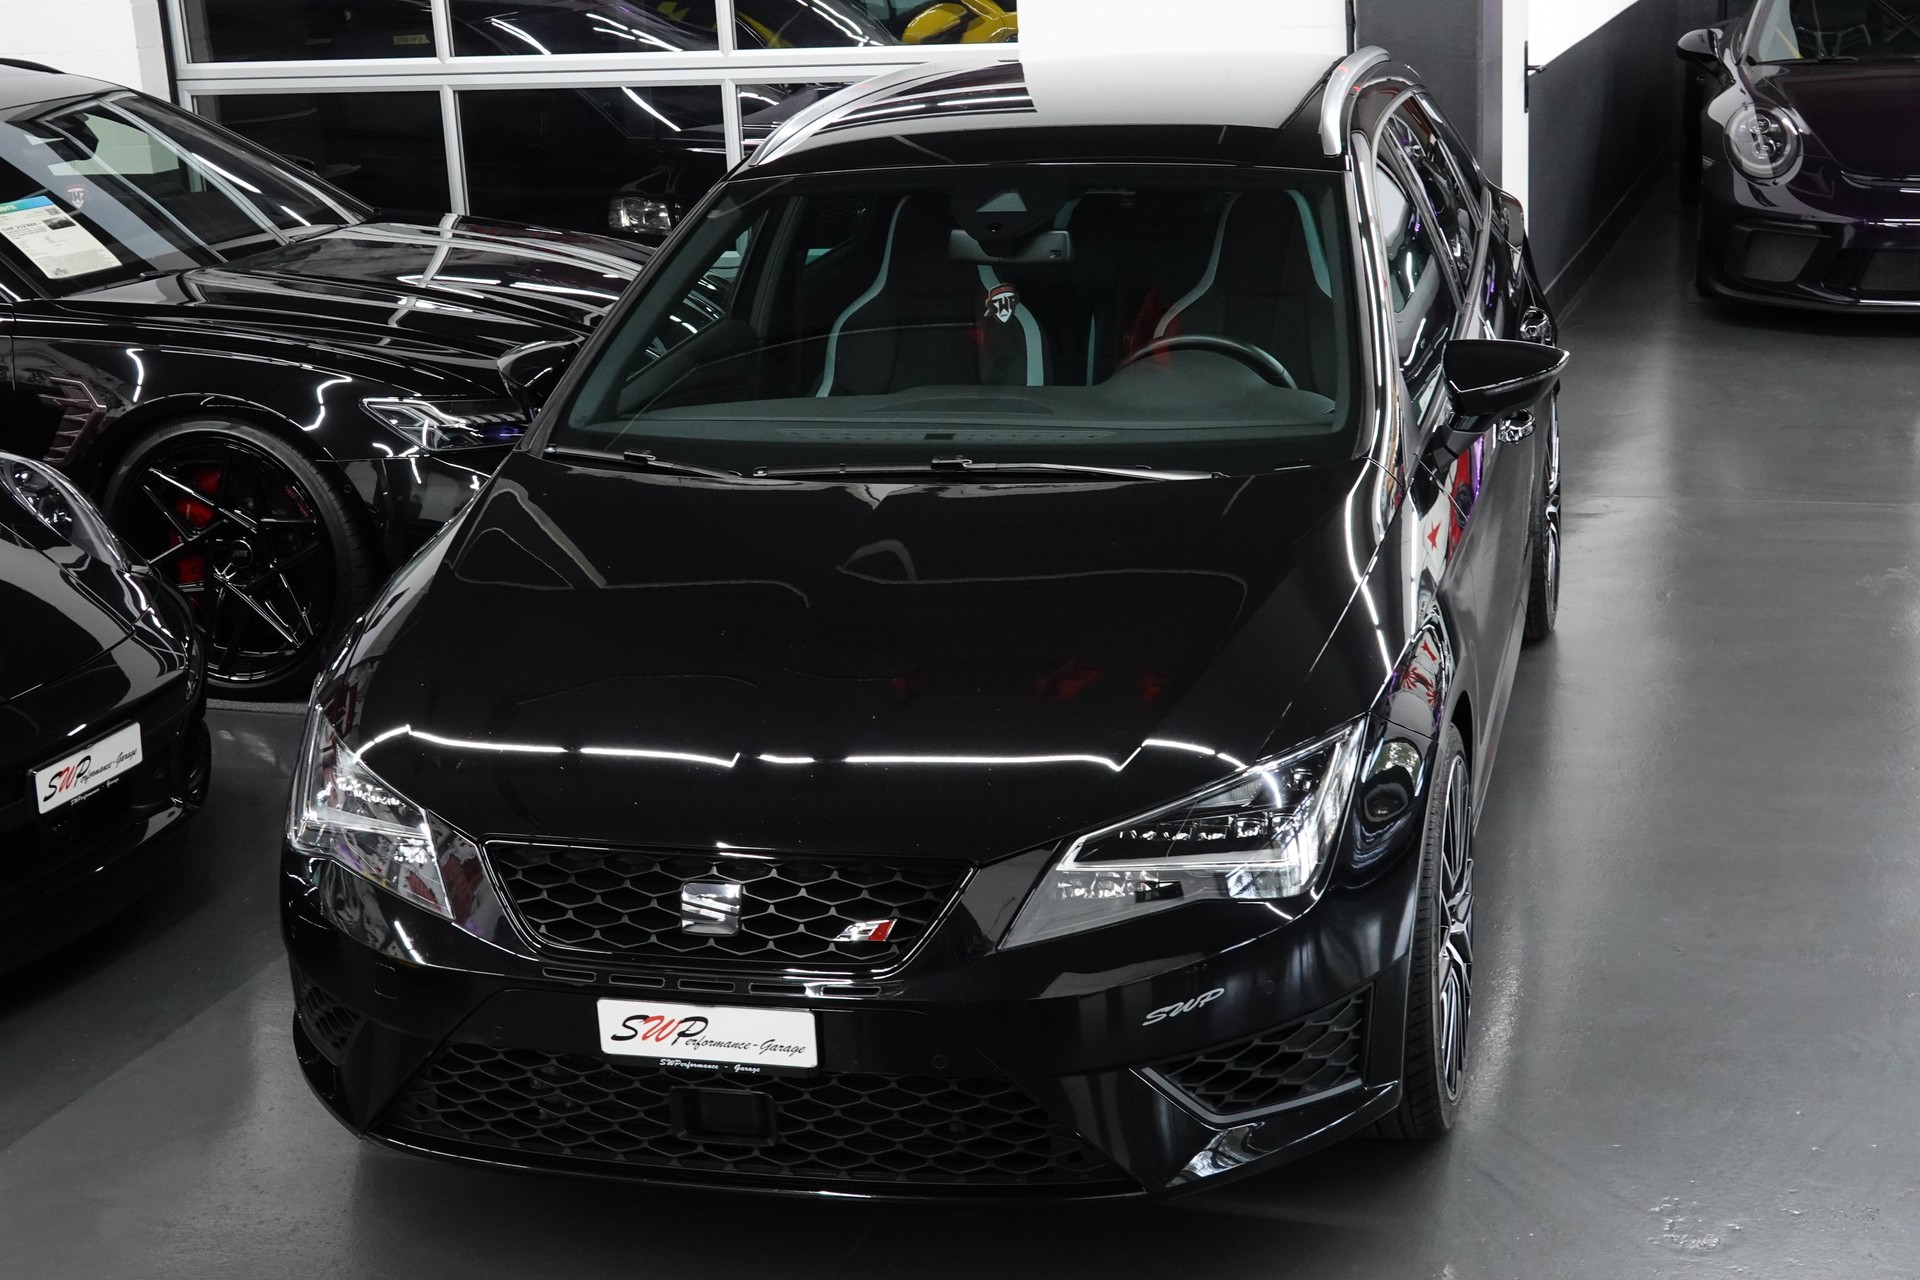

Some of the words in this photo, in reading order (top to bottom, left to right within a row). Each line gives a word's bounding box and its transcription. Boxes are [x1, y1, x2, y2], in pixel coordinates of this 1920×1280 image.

[1142, 988, 1225, 1026] SWP
[659, 1058, 720, 1070] SWPerformance
[733, 1063, 761, 1074] Garage
